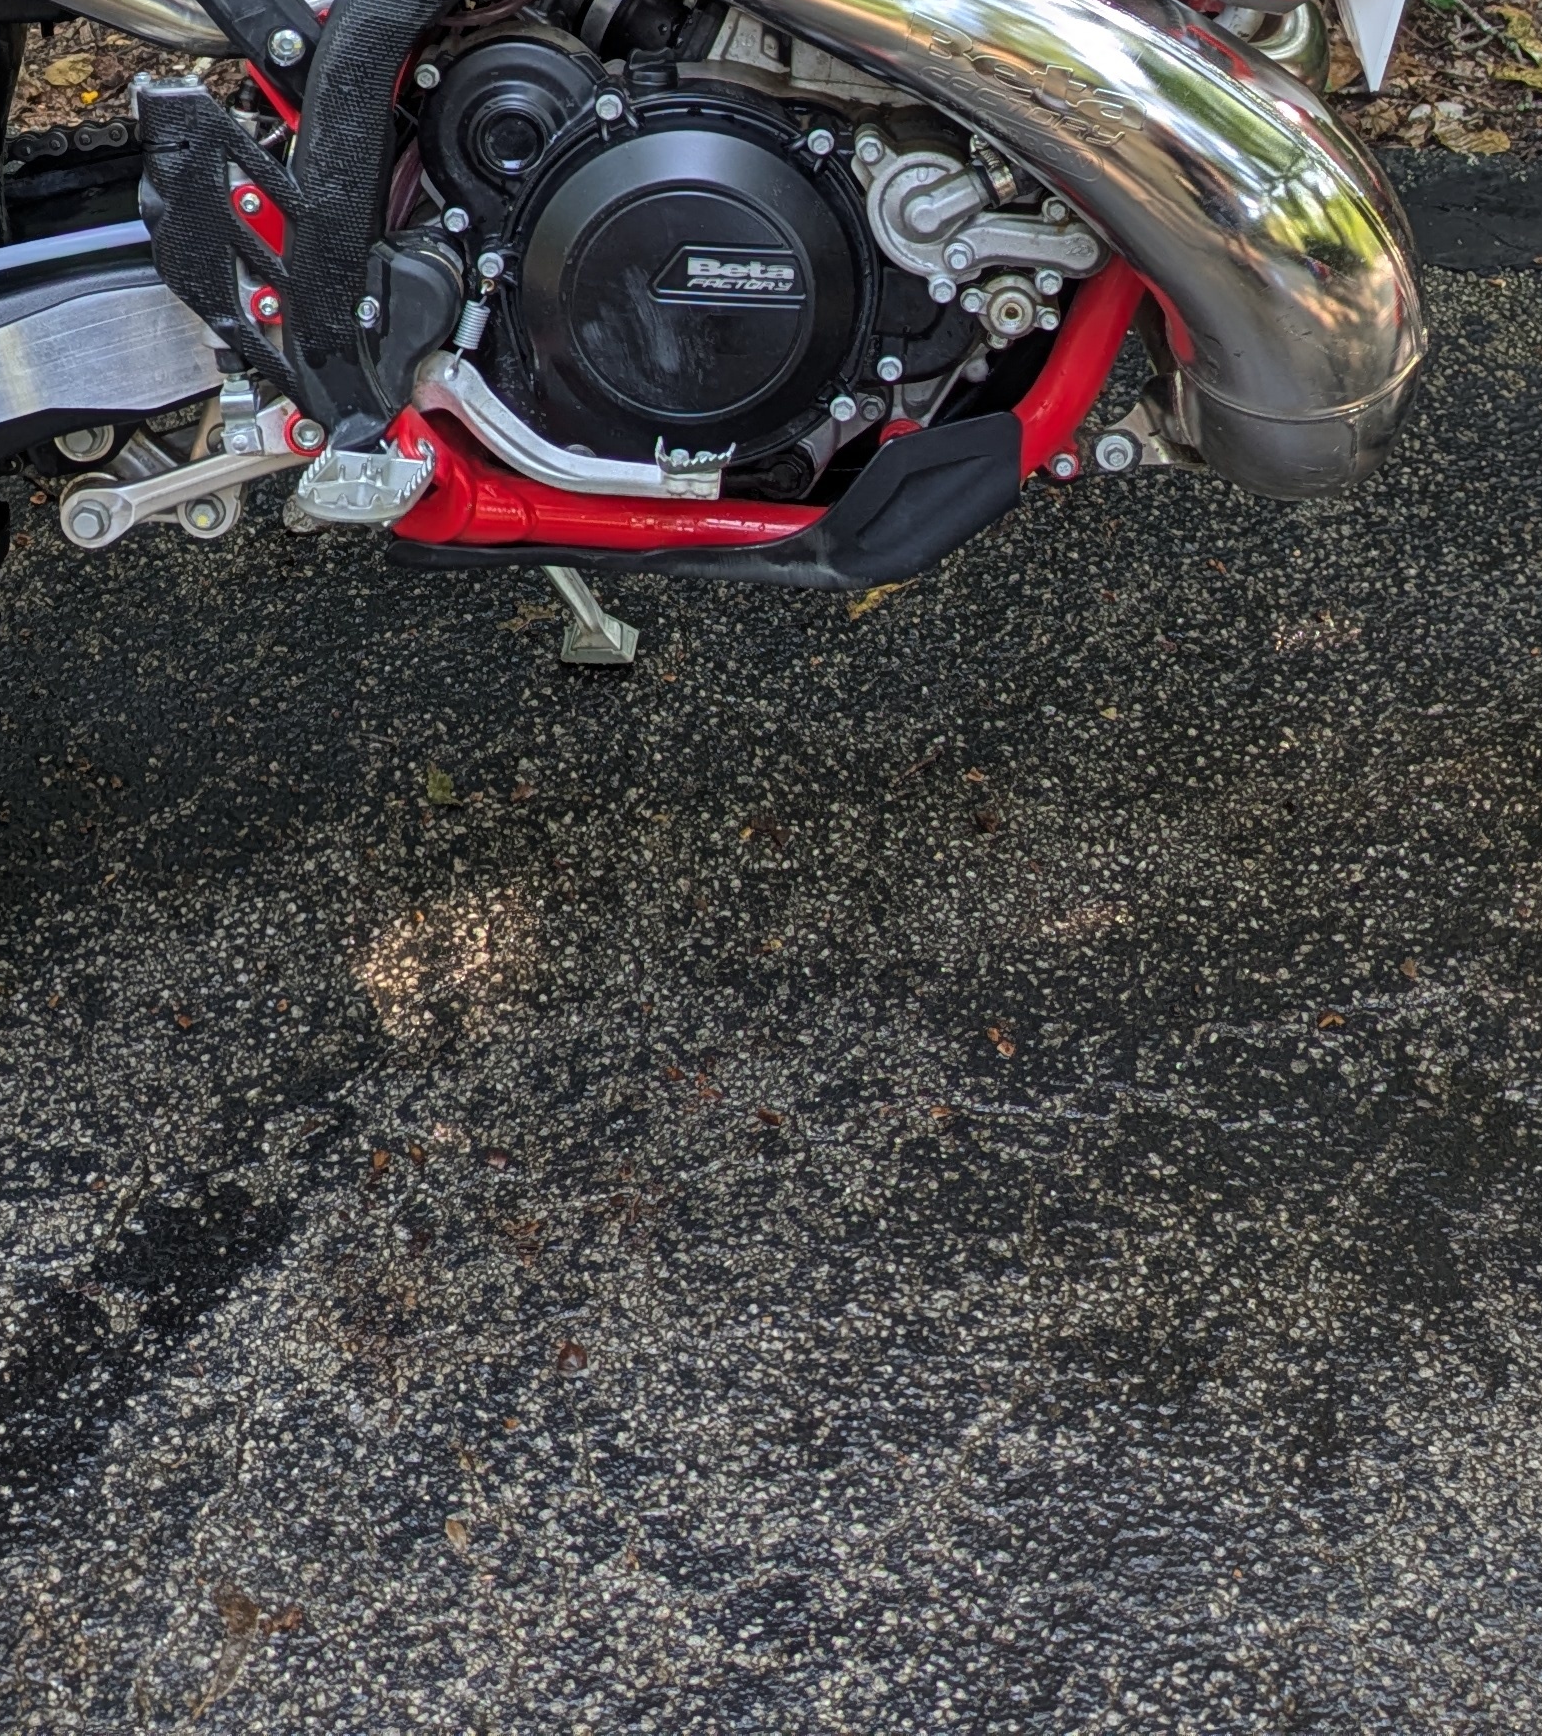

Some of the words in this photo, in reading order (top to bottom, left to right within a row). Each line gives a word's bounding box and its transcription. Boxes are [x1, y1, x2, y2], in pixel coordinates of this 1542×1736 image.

[906, 11, 1147, 131] Beta
[918, 65, 1126, 148] FACTORY
[686, 277, 795, 292] FACTORY
[687, 256, 795, 280] Beta
